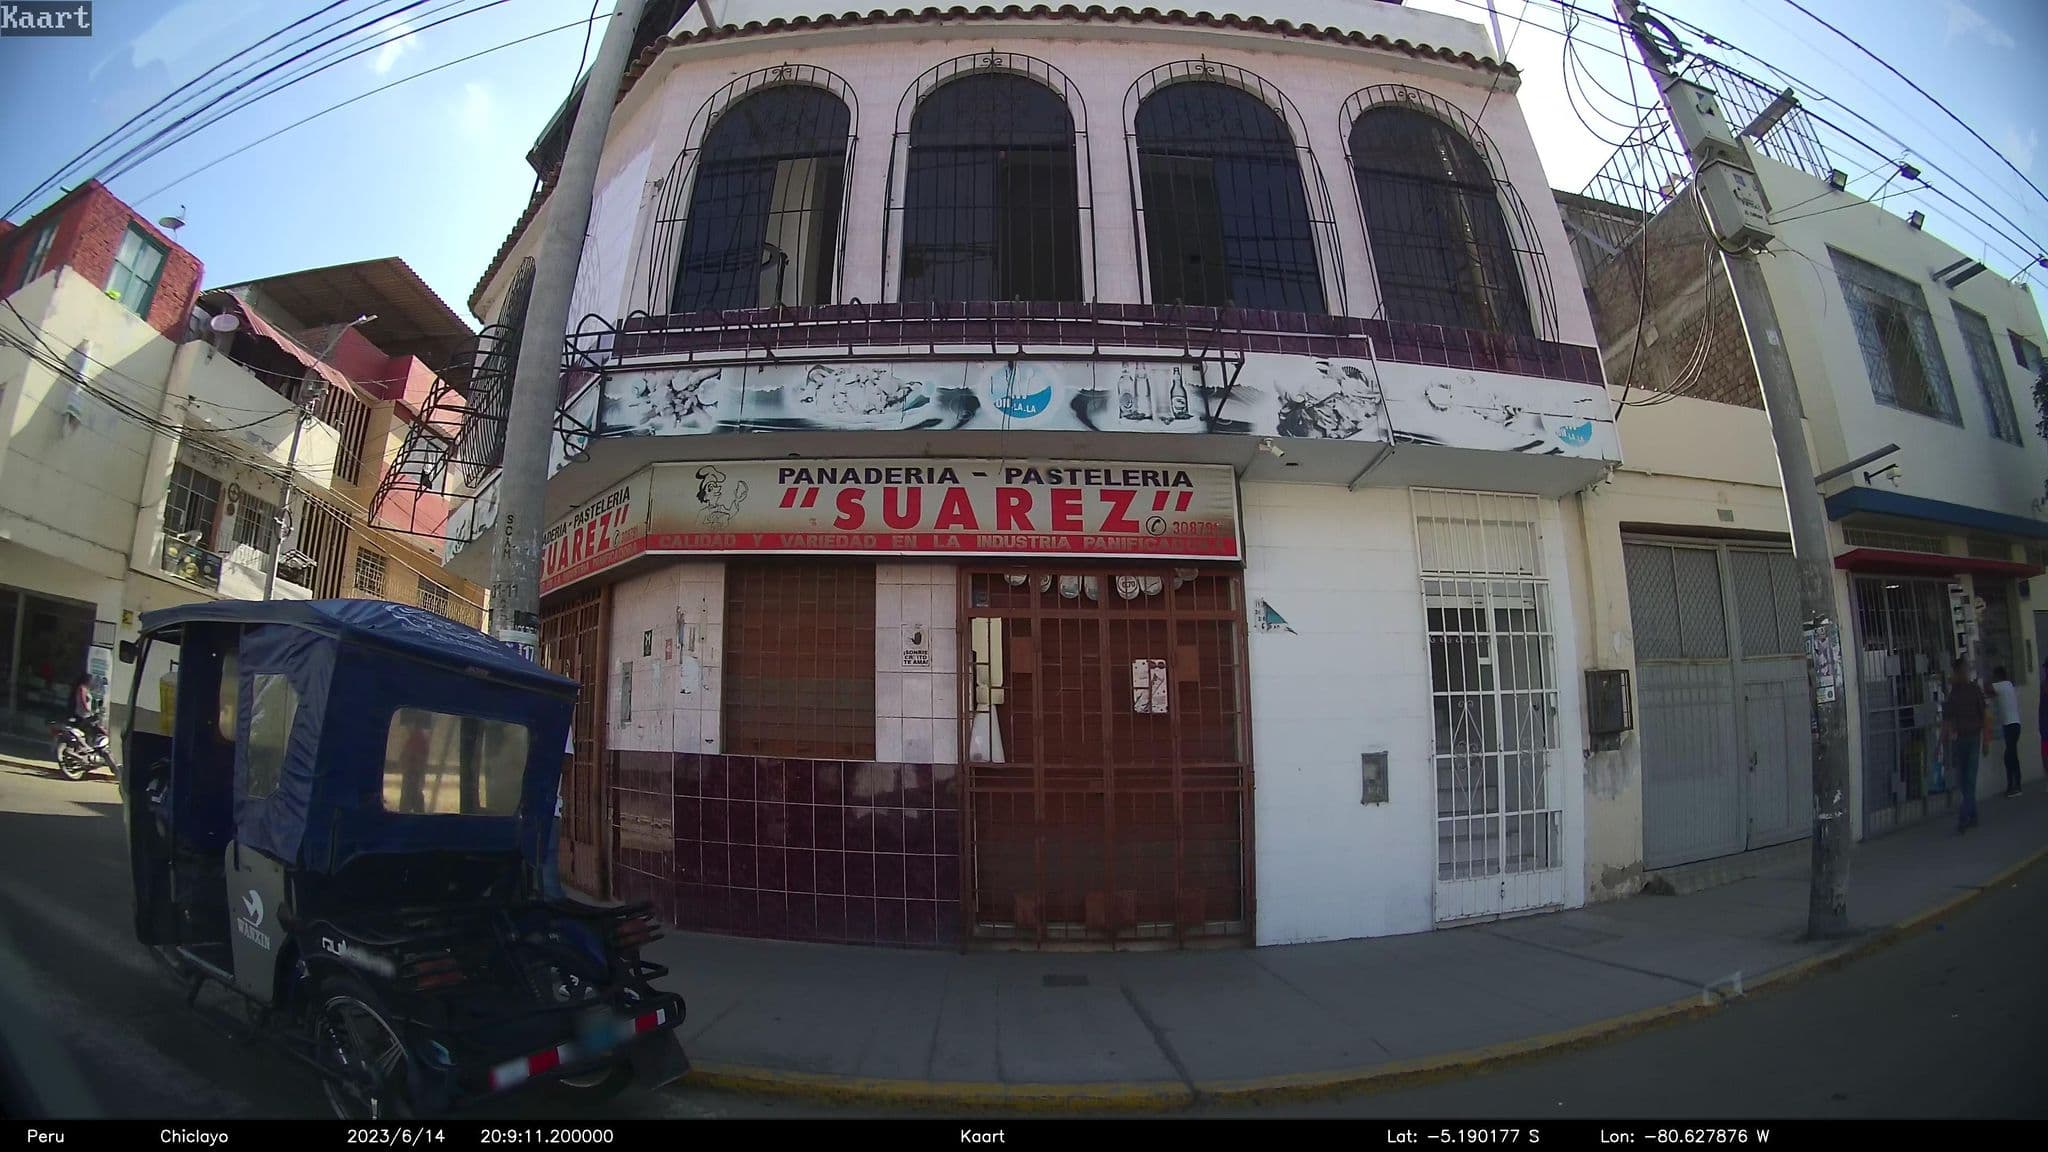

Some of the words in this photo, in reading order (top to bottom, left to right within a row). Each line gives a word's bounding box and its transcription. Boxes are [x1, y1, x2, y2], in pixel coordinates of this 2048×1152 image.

[778, 467, 960, 485] PANADERIA
[1005, 467, 1194, 488] PASTELERIA
[541, 520, 568, 549] ADERIA
[573, 485, 631, 528] PASTELERIA
[658, 533, 737, 548] CALIDAD
[752, 534, 763, 547] Y
[780, 534, 877, 549] VARIEDAD
[891, 535, 917, 548] EN
[933, 535, 960, 548] LA
[976, 535, 1071, 550] INDUSTRIA
